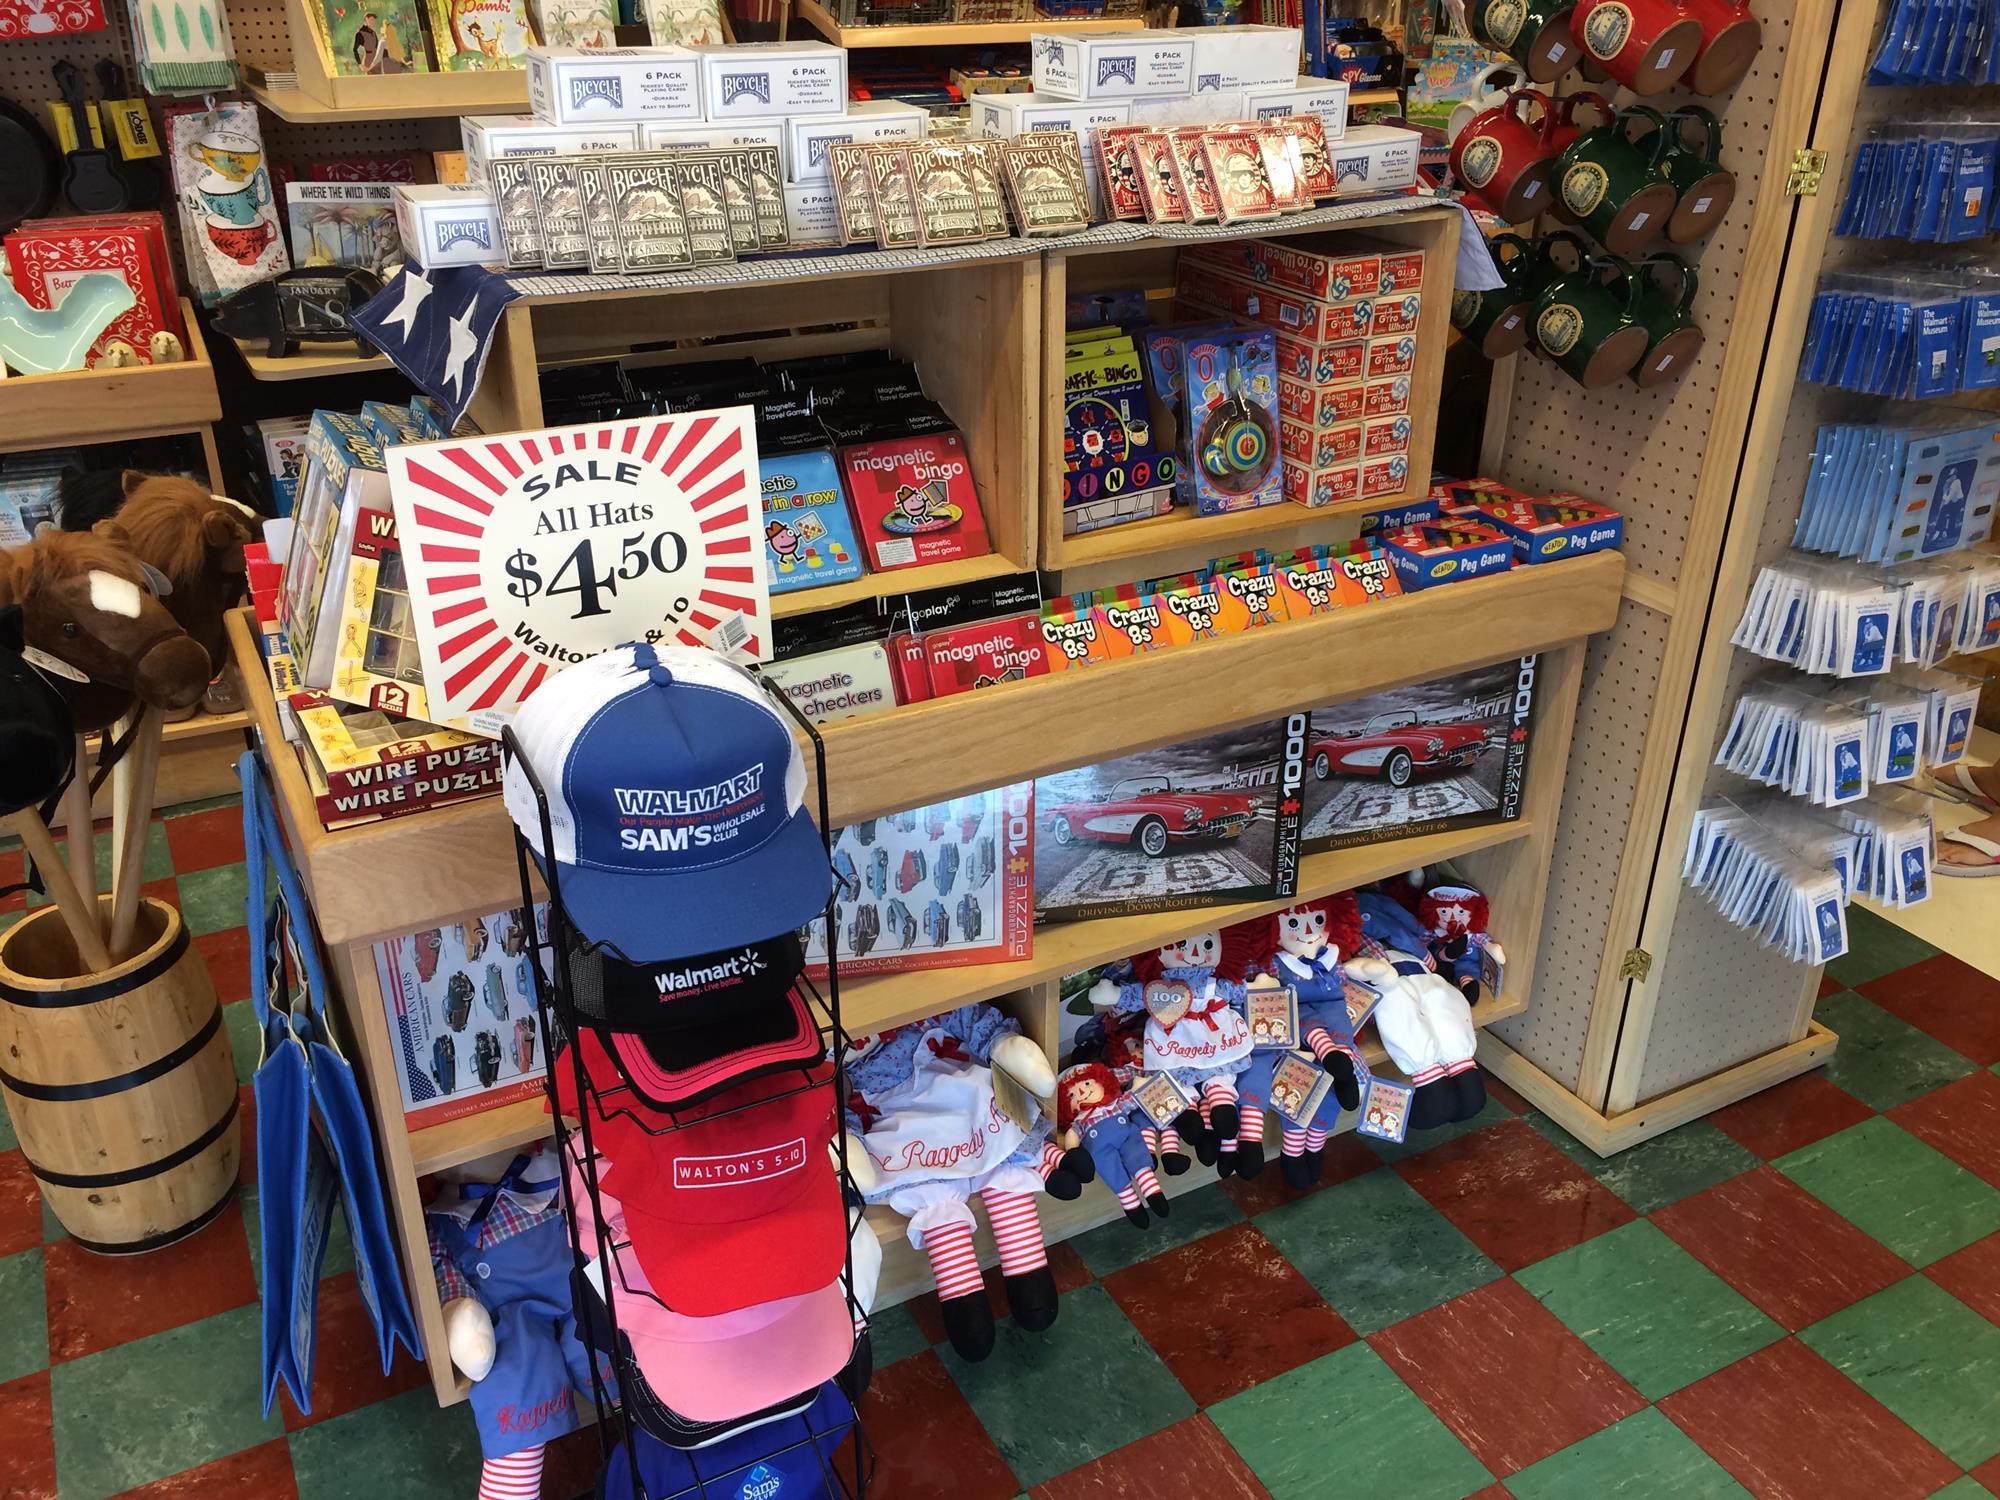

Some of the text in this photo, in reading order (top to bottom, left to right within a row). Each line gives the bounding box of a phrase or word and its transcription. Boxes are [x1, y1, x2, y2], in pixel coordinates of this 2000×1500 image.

[646, 72, 652, 80] 6
[792, 68, 798, 76] 6
[1099, 58, 1136, 85] BICYCLE
[1342, 67, 1361, 83] SPY
[572, 80, 621, 107] BICYCLE
[723, 75, 769, 103] BICYCLE
[1309, 99, 1315, 107] 6
[129, 110, 148, 145] LODGE
[875, 129, 881, 137] 6
[581, 142, 588, 150] 6
[1216, 138, 1256, 159] BICYCLE
[1963, 148, 1974, 156] The
[911, 148, 969, 182] BICYCLE
[1011, 150, 1066, 179] BICYCLE
[1338, 158, 1368, 182] BICYCLE
[300, 186, 391, 199] WHERE THE WILD THINGS
[612, 167, 679, 204] BICYCLE
[802, 197, 808, 205] 6
[438, 222, 490, 250] BICYCLE
[290, 286, 340, 296] JANUARY
[1923, 310, 1935, 319] The
[1978, 301, 1990, 310] The
[1330, 318, 1351, 331] Gyro
[1379, 313, 1400, 325] Gyro
[1923, 316, 1948, 328] Walmart
[1922, 325, 1948, 335] Museum
[1190, 343, 1218, 360] WHIRL
[1374, 354, 1394, 366] Gyro
[1065, 364, 1137, 390] RAFFIC BINGO
[877, 384, 907, 395] Magnetic
[879, 392, 899, 402] Travel
[765, 401, 796, 413] Magnetic
[1370, 395, 1390, 405] Gyro
[765, 410, 785, 420] Travel
[1371, 435, 1391, 445] Gyro
[853, 449, 936, 472] magnetic
[522, 460, 643, 501] SALE
[914, 461, 964, 481] bingo
[1368, 474, 1388, 484] Gyro
[791, 490, 838, 508] a row
[533, 501, 654, 536] All Hats
[1383, 511, 1431, 529] Peg Game
[919, 539, 952, 550] magnetic
[1512, 535, 1530, 551] Game
[1571, 533, 1587, 549] Peg
[1590, 528, 1616, 544] Game
[921, 545, 962, 557] travel game
[1342, 558, 1390, 579] Crazy
[1388, 551, 1419, 573] Peg Game
[1460, 558, 1477, 573] Peg
[1481, 552, 1506, 567] Game
[779, 566, 858, 585] magnetic travel game
[1227, 573, 1275, 596] Crazy
[1287, 567, 1336, 591] Crazy
[1361, 575, 1385, 595] 8s
[995, 587, 1025, 598] Magnetic
[995, 592, 1039, 607] Travel Games
[1306, 587, 1331, 607] 8s
[664, 597, 690, 625] 10
[912, 604, 948, 621] goplay
[1168, 592, 1219, 615] Crazy
[1246, 593, 1269, 613] 8s
[1107, 606, 1160, 630] Crazy
[1187, 611, 1211, 631] 8s
[1042, 618, 1097, 642] Crazy
[1127, 625, 1152, 645] 8s
[933, 636, 1015, 664] magnetic
[992, 647, 1041, 669] bingo
[1062, 638, 1088, 660] 8s
[378, 684, 405, 706] 12
[804, 688, 883, 716] checkers
[378, 702, 404, 713] PUZZLES
[1283, 714, 1305, 797] 1000
[345, 758, 419, 789] WIRE
[1507, 744, 1525, 818] PUZZLE
[334, 784, 406, 813] WIRE
[619, 817, 637, 826] Our
[675, 815, 702, 826] Make
[620, 803, 766, 851] SAM'S WHOLESALE
[713, 827, 739, 844] CLUB
[1277, 817, 1288, 871] EUROGRAPHICS
[1330, 822, 1448, 848] DRIVING DOWN ROUTE 66
[1282, 815, 1298, 896] PUZZLE
[1008, 876, 1017, 934] EUROGRAPHICS
[1078, 906, 1123, 918] DRIVING
[1127, 902, 1162, 912] DOWN
[1165, 897, 1199, 908] ROUTE
[1016, 875, 1028, 956] PUZZLE
[878, 957, 903, 966] CARS
[654, 959, 741, 994] Walmart
[659, 976, 744, 1003] Save money. Live better.
[1152, 991, 1181, 1003] 100
[402, 971, 424, 1052] AMERICAN CARS
[1166, 1039, 1216, 1057] Raggedy
[901, 1129, 986, 1170] Raggedy
[679, 1158, 766, 1179] WALTON'S
[743, 1476, 780, 1500] Sam's
